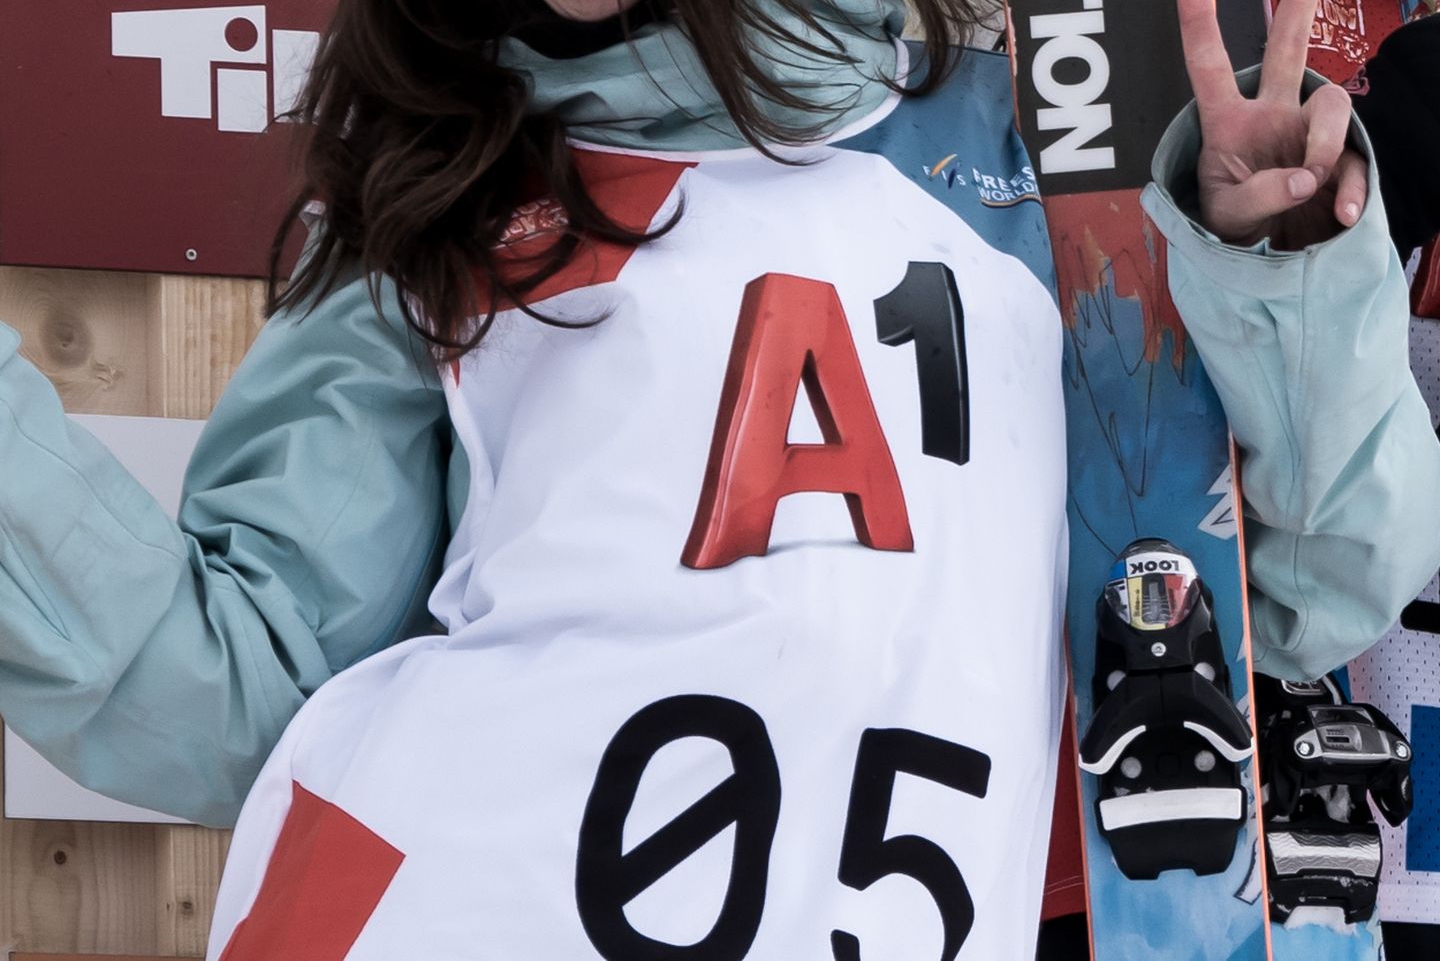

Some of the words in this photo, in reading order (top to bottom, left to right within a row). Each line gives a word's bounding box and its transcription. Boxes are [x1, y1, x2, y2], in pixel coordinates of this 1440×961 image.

[922, 165, 966, 186] FIS
[680, 261, 970, 570] A1
[1129, 560, 1180, 575] LOOK
[575, 693, 992, 961] 05
